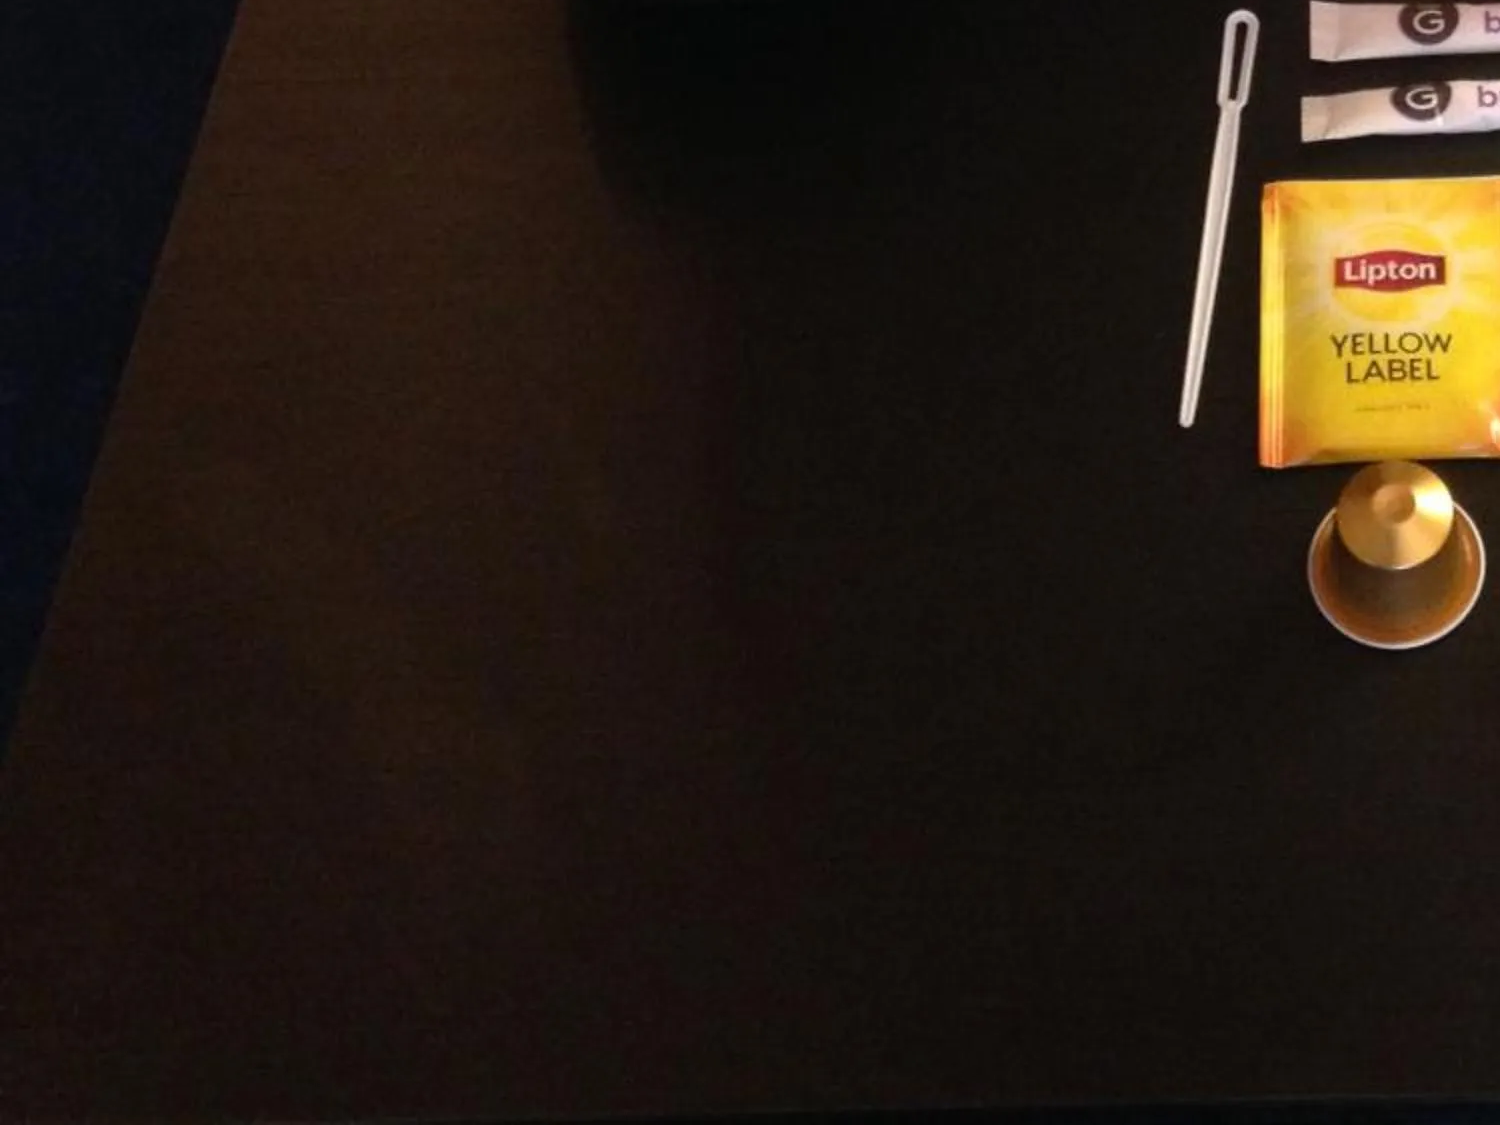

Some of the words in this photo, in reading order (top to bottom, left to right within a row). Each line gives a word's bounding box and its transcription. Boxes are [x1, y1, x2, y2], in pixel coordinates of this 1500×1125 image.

[1412, 10, 1445, 34] G
[1405, 87, 1438, 110] G
[1343, 259, 1437, 286] Lipton
[1330, 332, 1452, 358] YELLOW
[1346, 358, 1440, 384] LABEL
